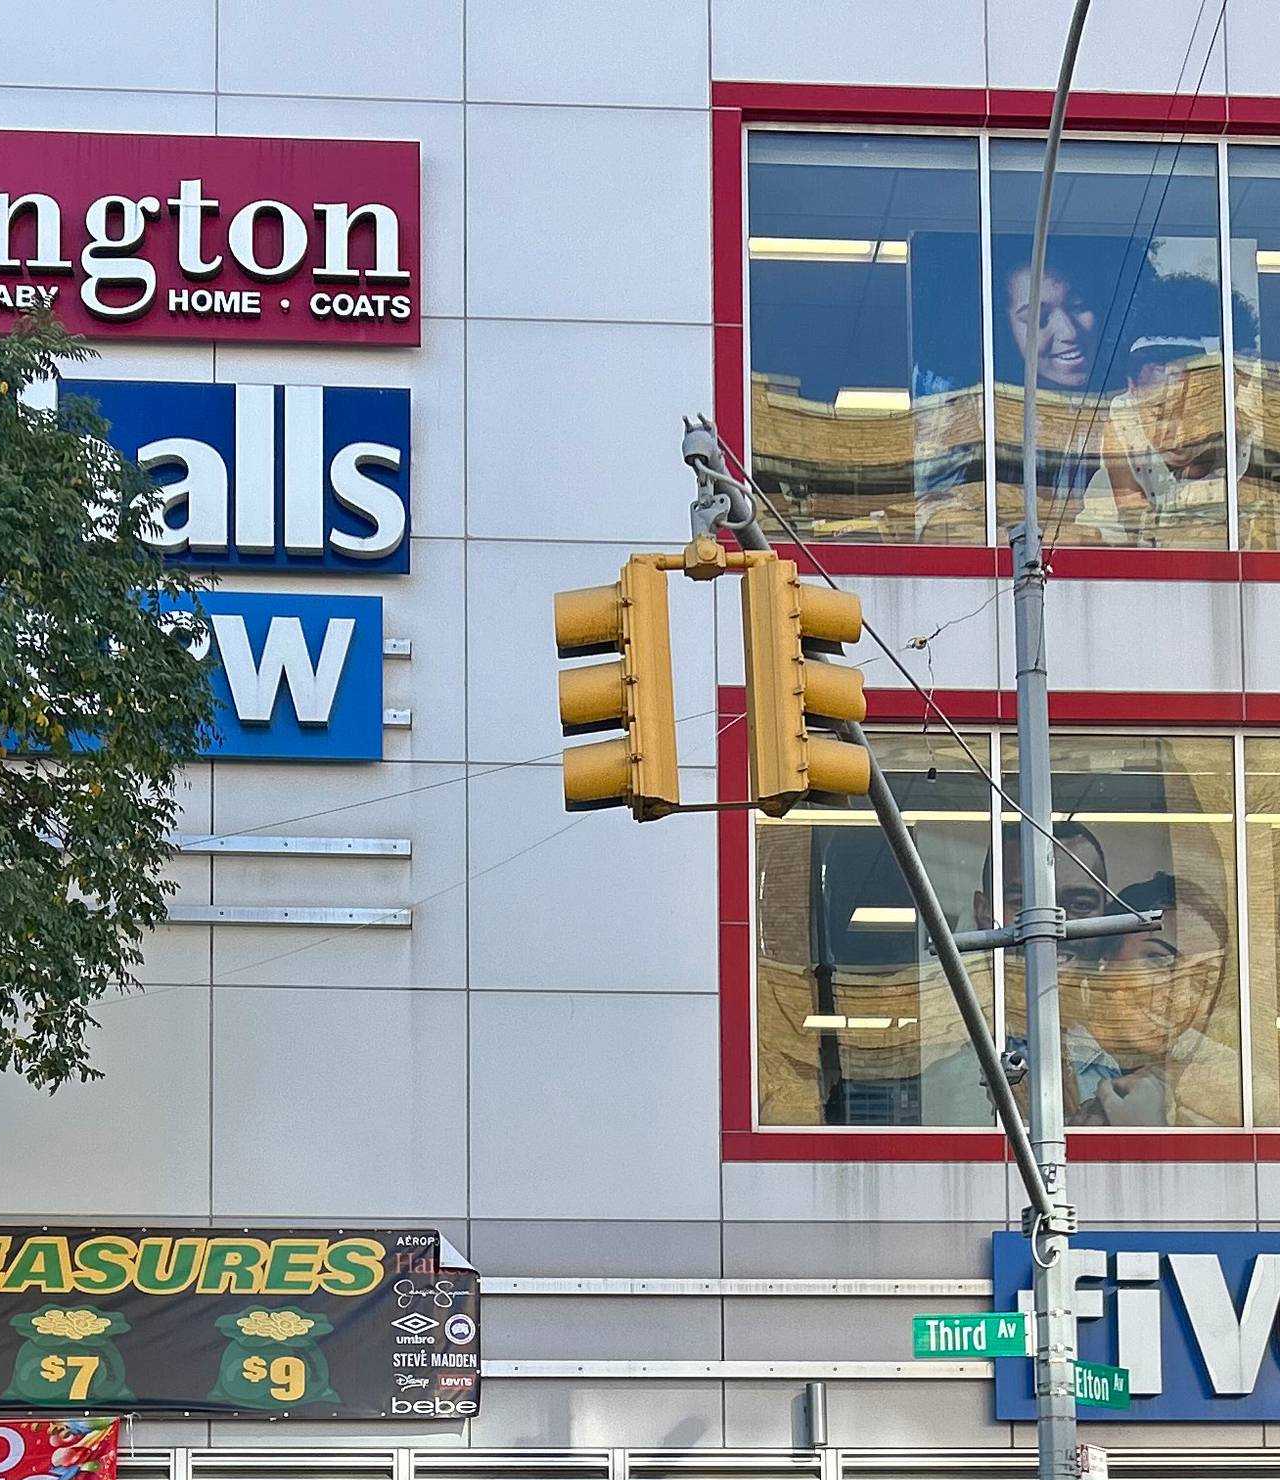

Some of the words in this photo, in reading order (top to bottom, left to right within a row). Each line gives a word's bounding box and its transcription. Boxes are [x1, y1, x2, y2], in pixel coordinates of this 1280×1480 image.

[168, 289, 261, 316] HOME
[310, 292, 411, 321] COATS
[396, 1333, 436, 1345] umbro
[925, 1318, 987, 1351] Third
[997, 1319, 1017, 1340] Av
[393, 1352, 427, 1368] STEVE
[431, 1353, 478, 1368] MADDEN
[40, 1355, 100, 1401] $7
[242, 1354, 307, 1402] $9
[1075, 1366, 1110, 1402] Elton
[390, 1396, 478, 1415] bebe
